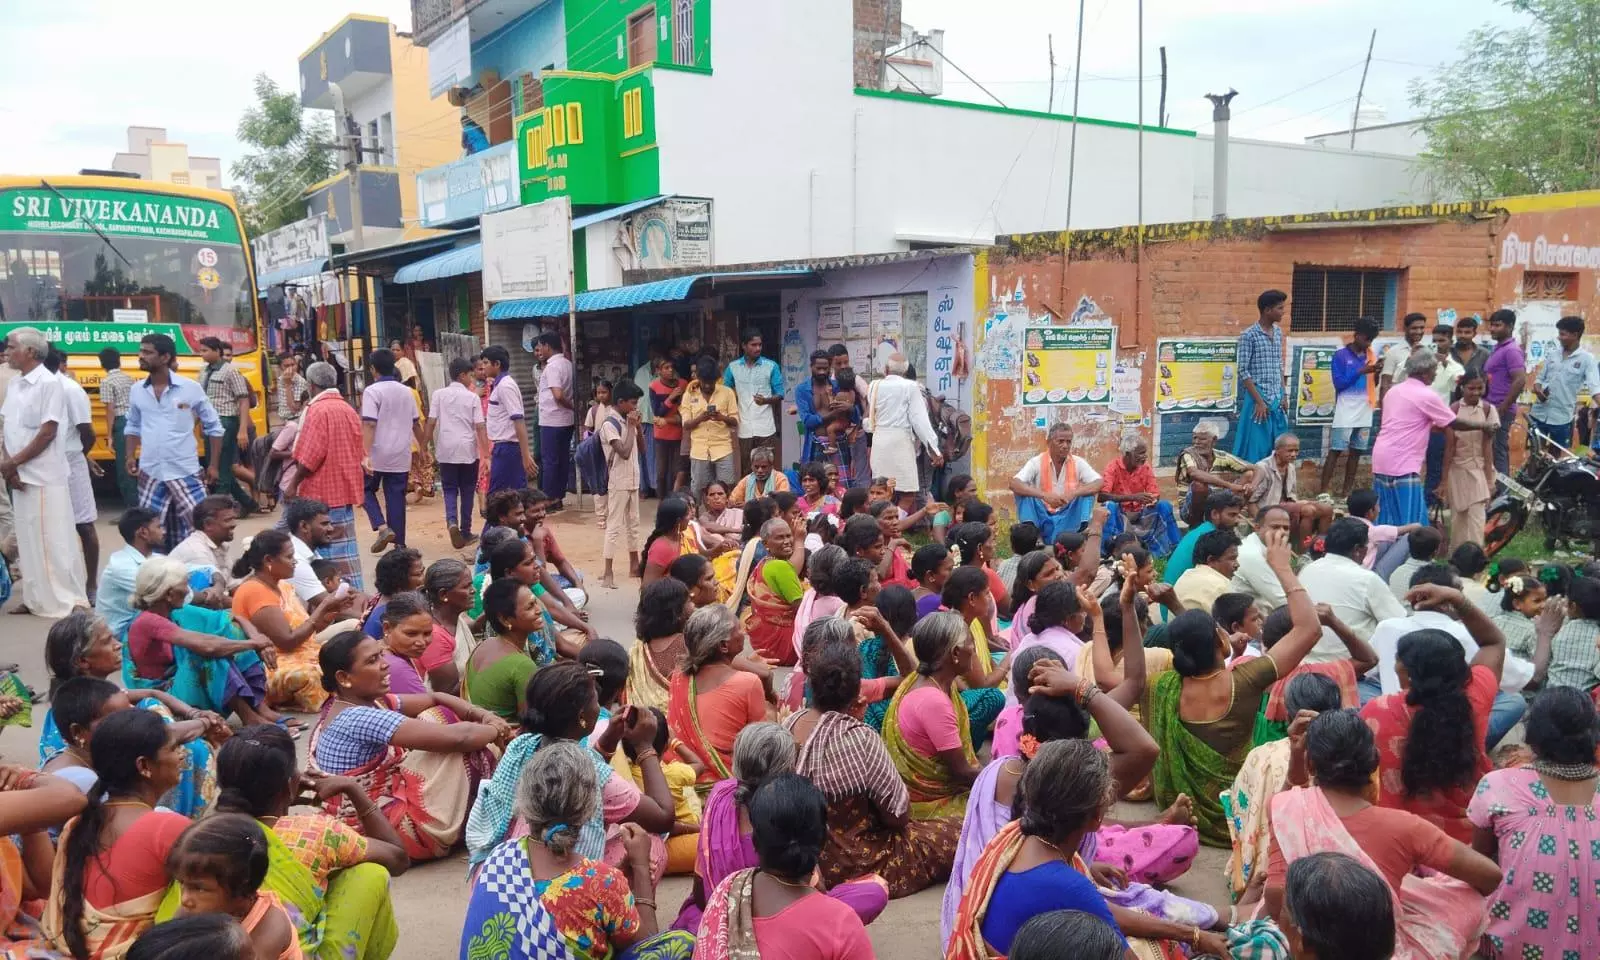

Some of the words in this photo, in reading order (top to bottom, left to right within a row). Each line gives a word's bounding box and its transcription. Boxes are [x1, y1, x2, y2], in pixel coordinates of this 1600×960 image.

[12, 196, 51, 217] SRI
[59, 198, 220, 229] VIVEKANANDA
[200, 252, 214, 264] 15
[64, 326, 91, 345] மூலம்
